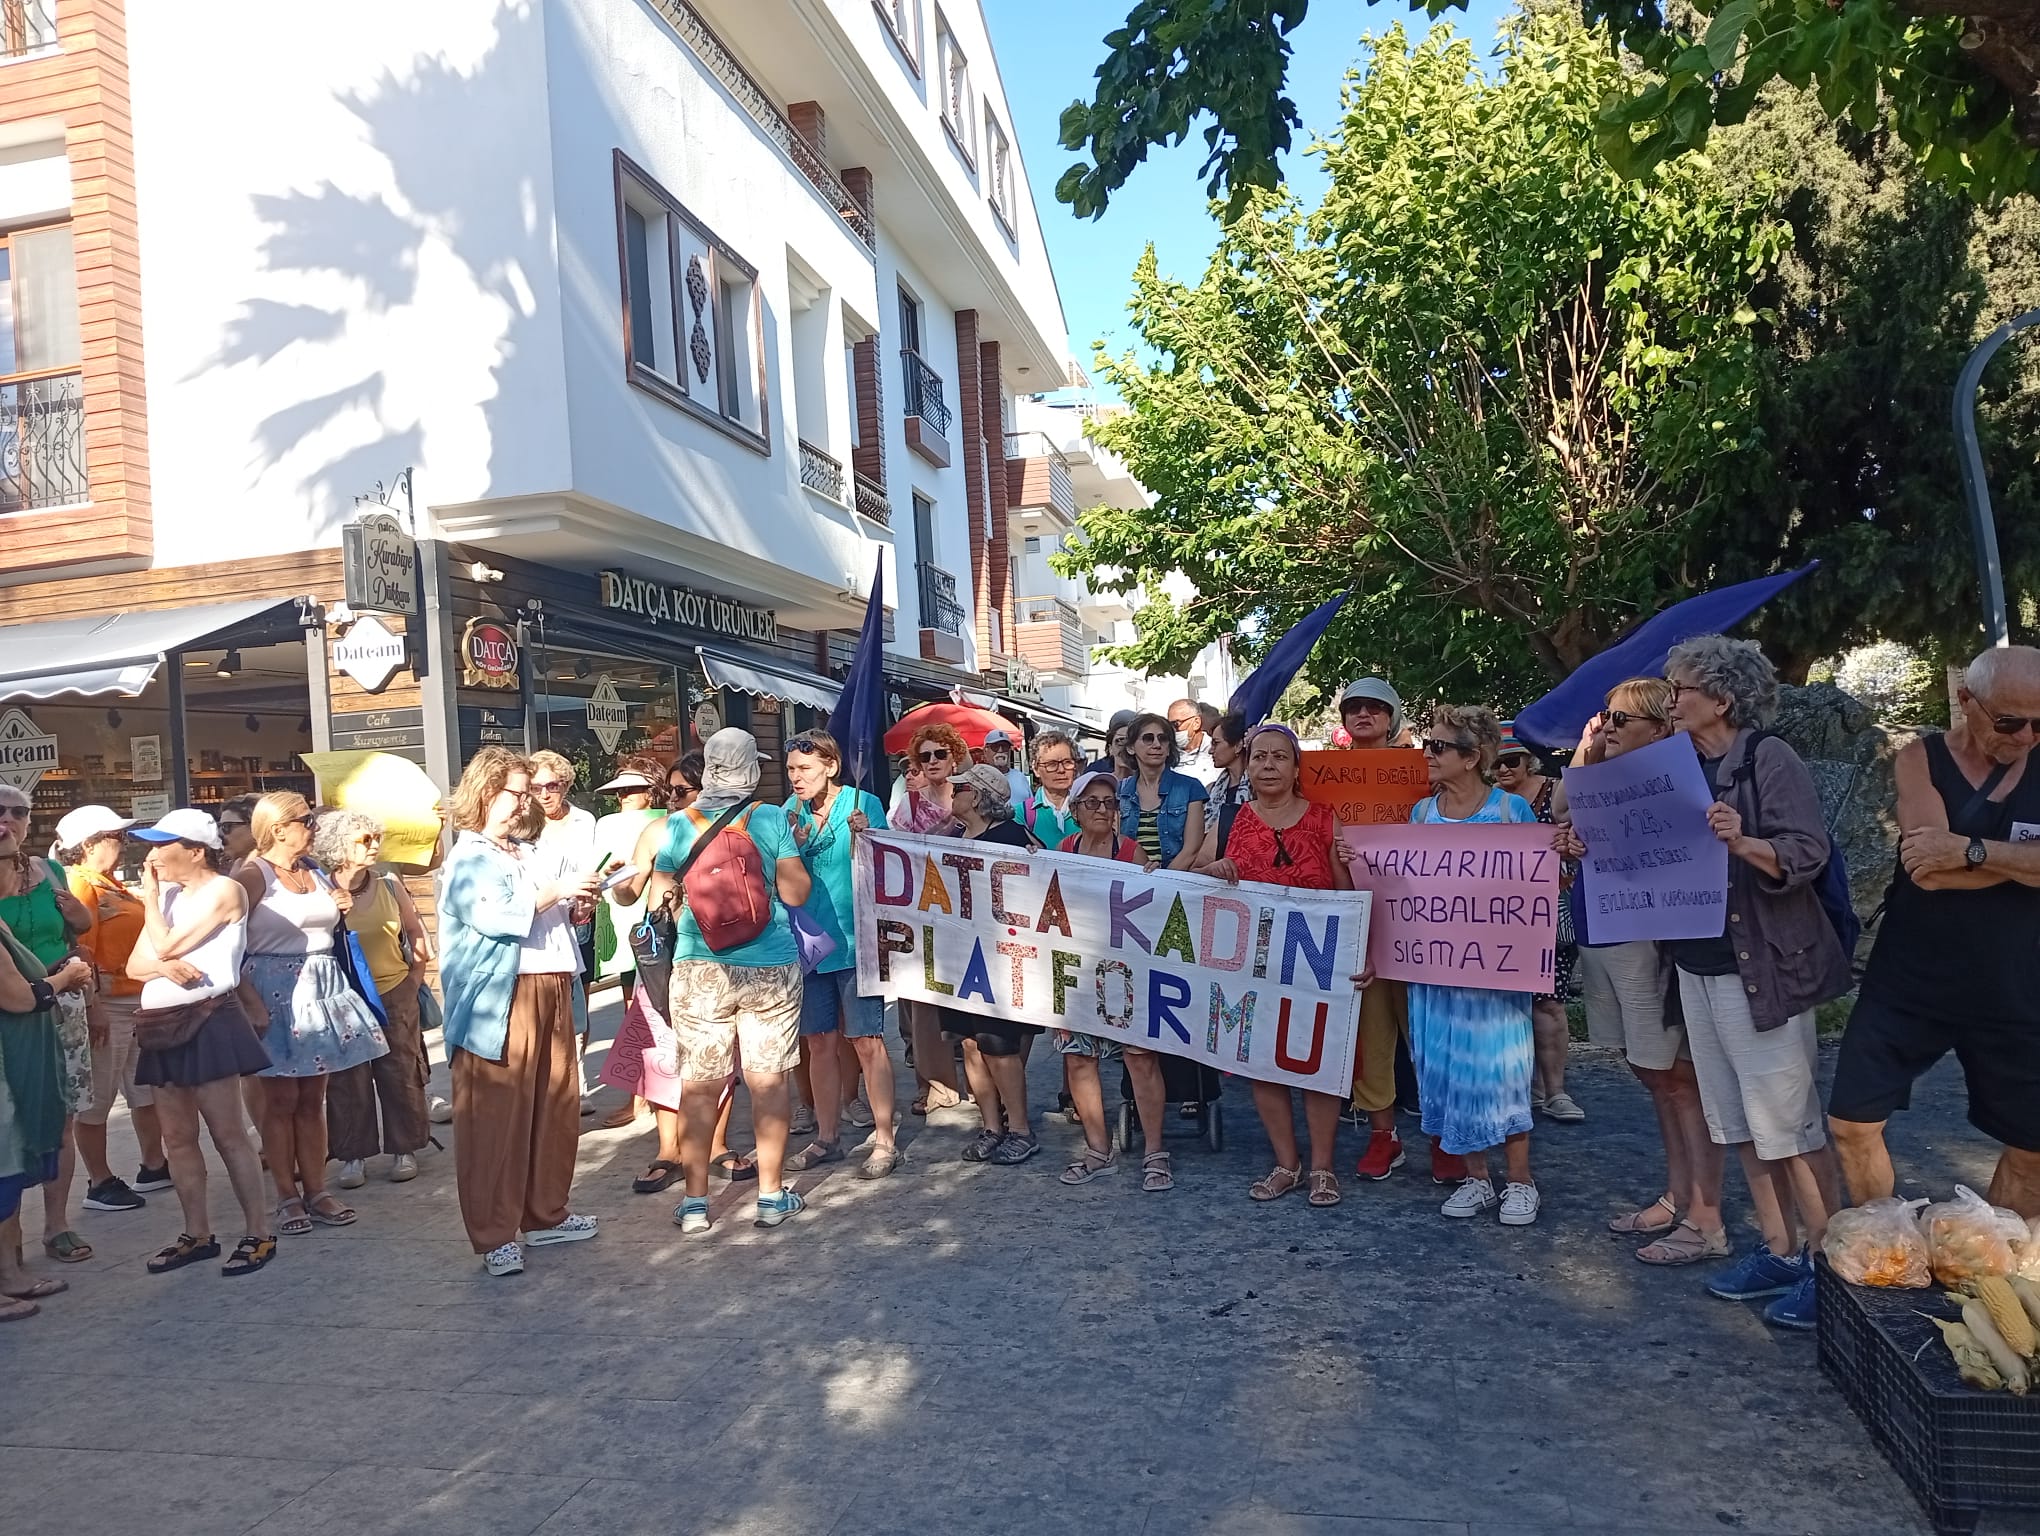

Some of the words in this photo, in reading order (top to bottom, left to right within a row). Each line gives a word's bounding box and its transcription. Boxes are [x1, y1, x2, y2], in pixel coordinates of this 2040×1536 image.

[367, 538, 413, 576] Kurabiye
[608, 572, 671, 625] DATÇA
[672, 586, 707, 629] KÖY
[709, 594, 779, 643] ÜRÜNLERİ
[472, 636, 515, 666] DATÇA
[366, 713, 391, 726] Cafe
[587, 702, 627, 726] Datçam
[1308, 765, 1367, 785] YARGI
[1376, 765, 1427, 785] DEĞİL
[1363, 849, 1550, 883] HAKLARIMIZ
[872, 840, 1073, 937] DATÇA
[1109, 880, 1340, 991] KADIN
[1386, 896, 1551, 928] TORBALARA
[1394, 938, 1519, 972] SIĞMAZ
[877, 919, 1328, 1075] PLATFORMU
